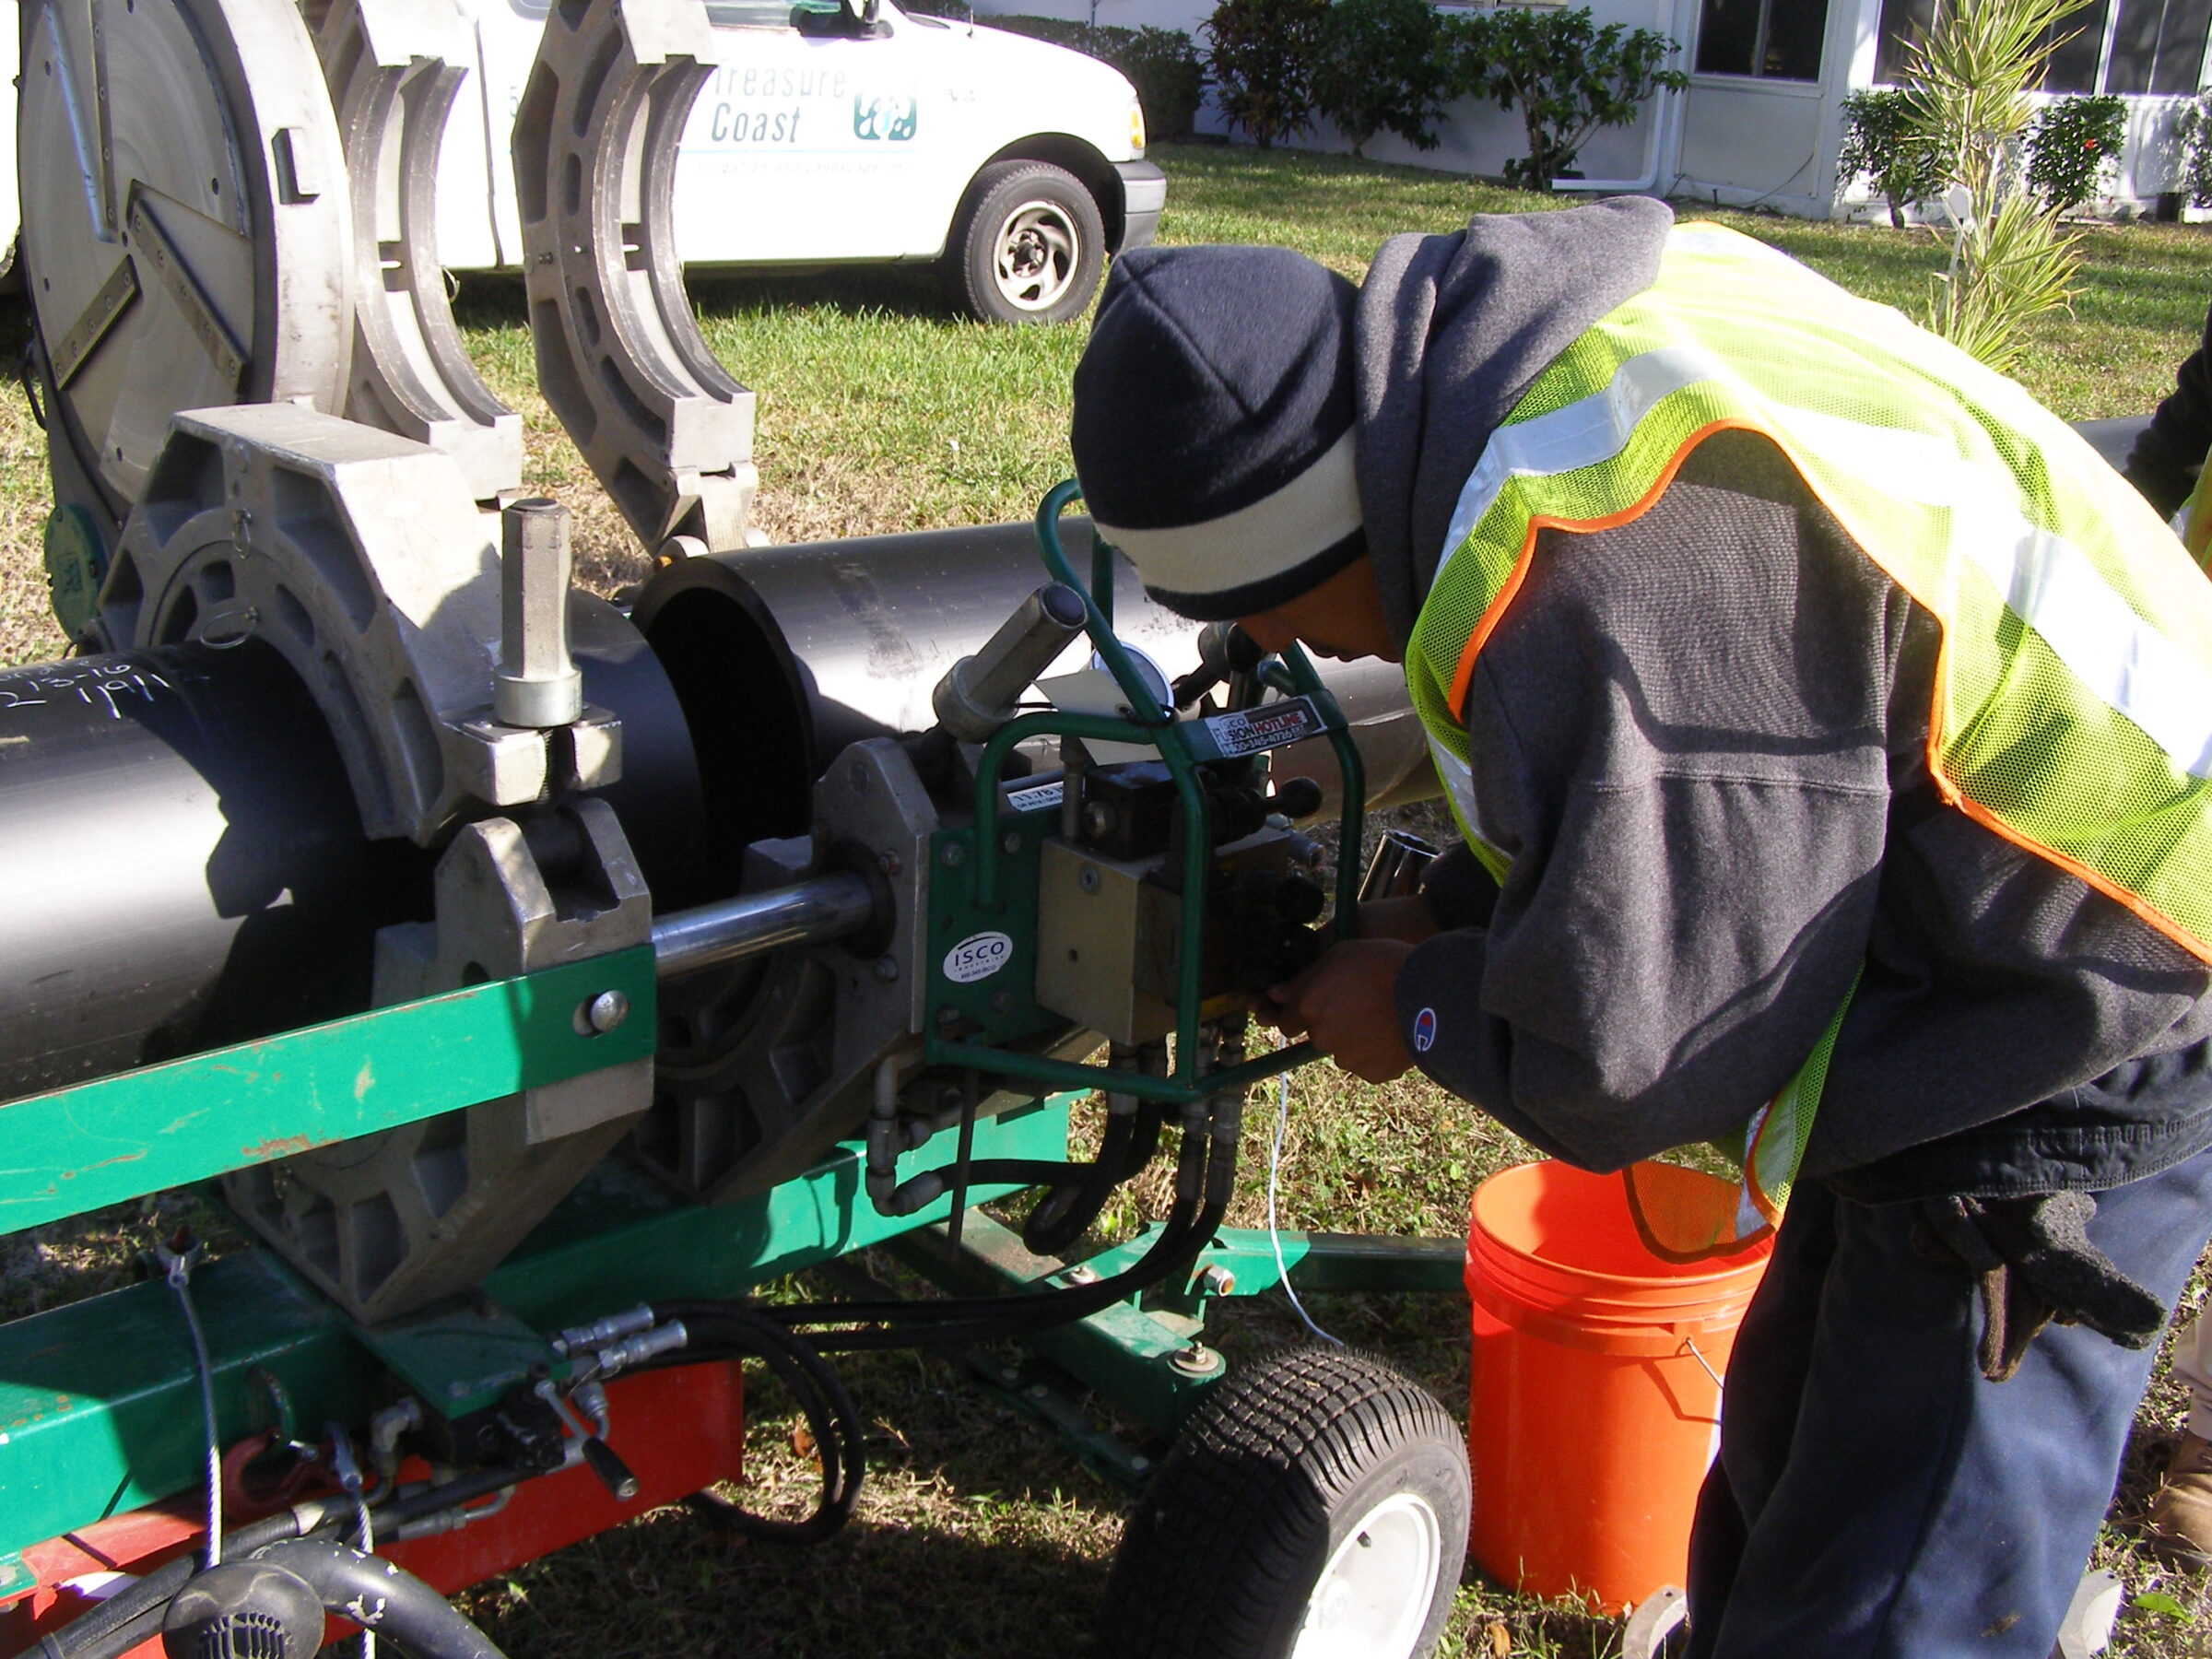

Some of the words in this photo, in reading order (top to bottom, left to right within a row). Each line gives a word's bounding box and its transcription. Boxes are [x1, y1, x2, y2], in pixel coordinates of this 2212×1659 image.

[714, 57, 846, 98] Treasure
[711, 101, 800, 143] Coast
[955, 941, 1005, 966] ISCO
